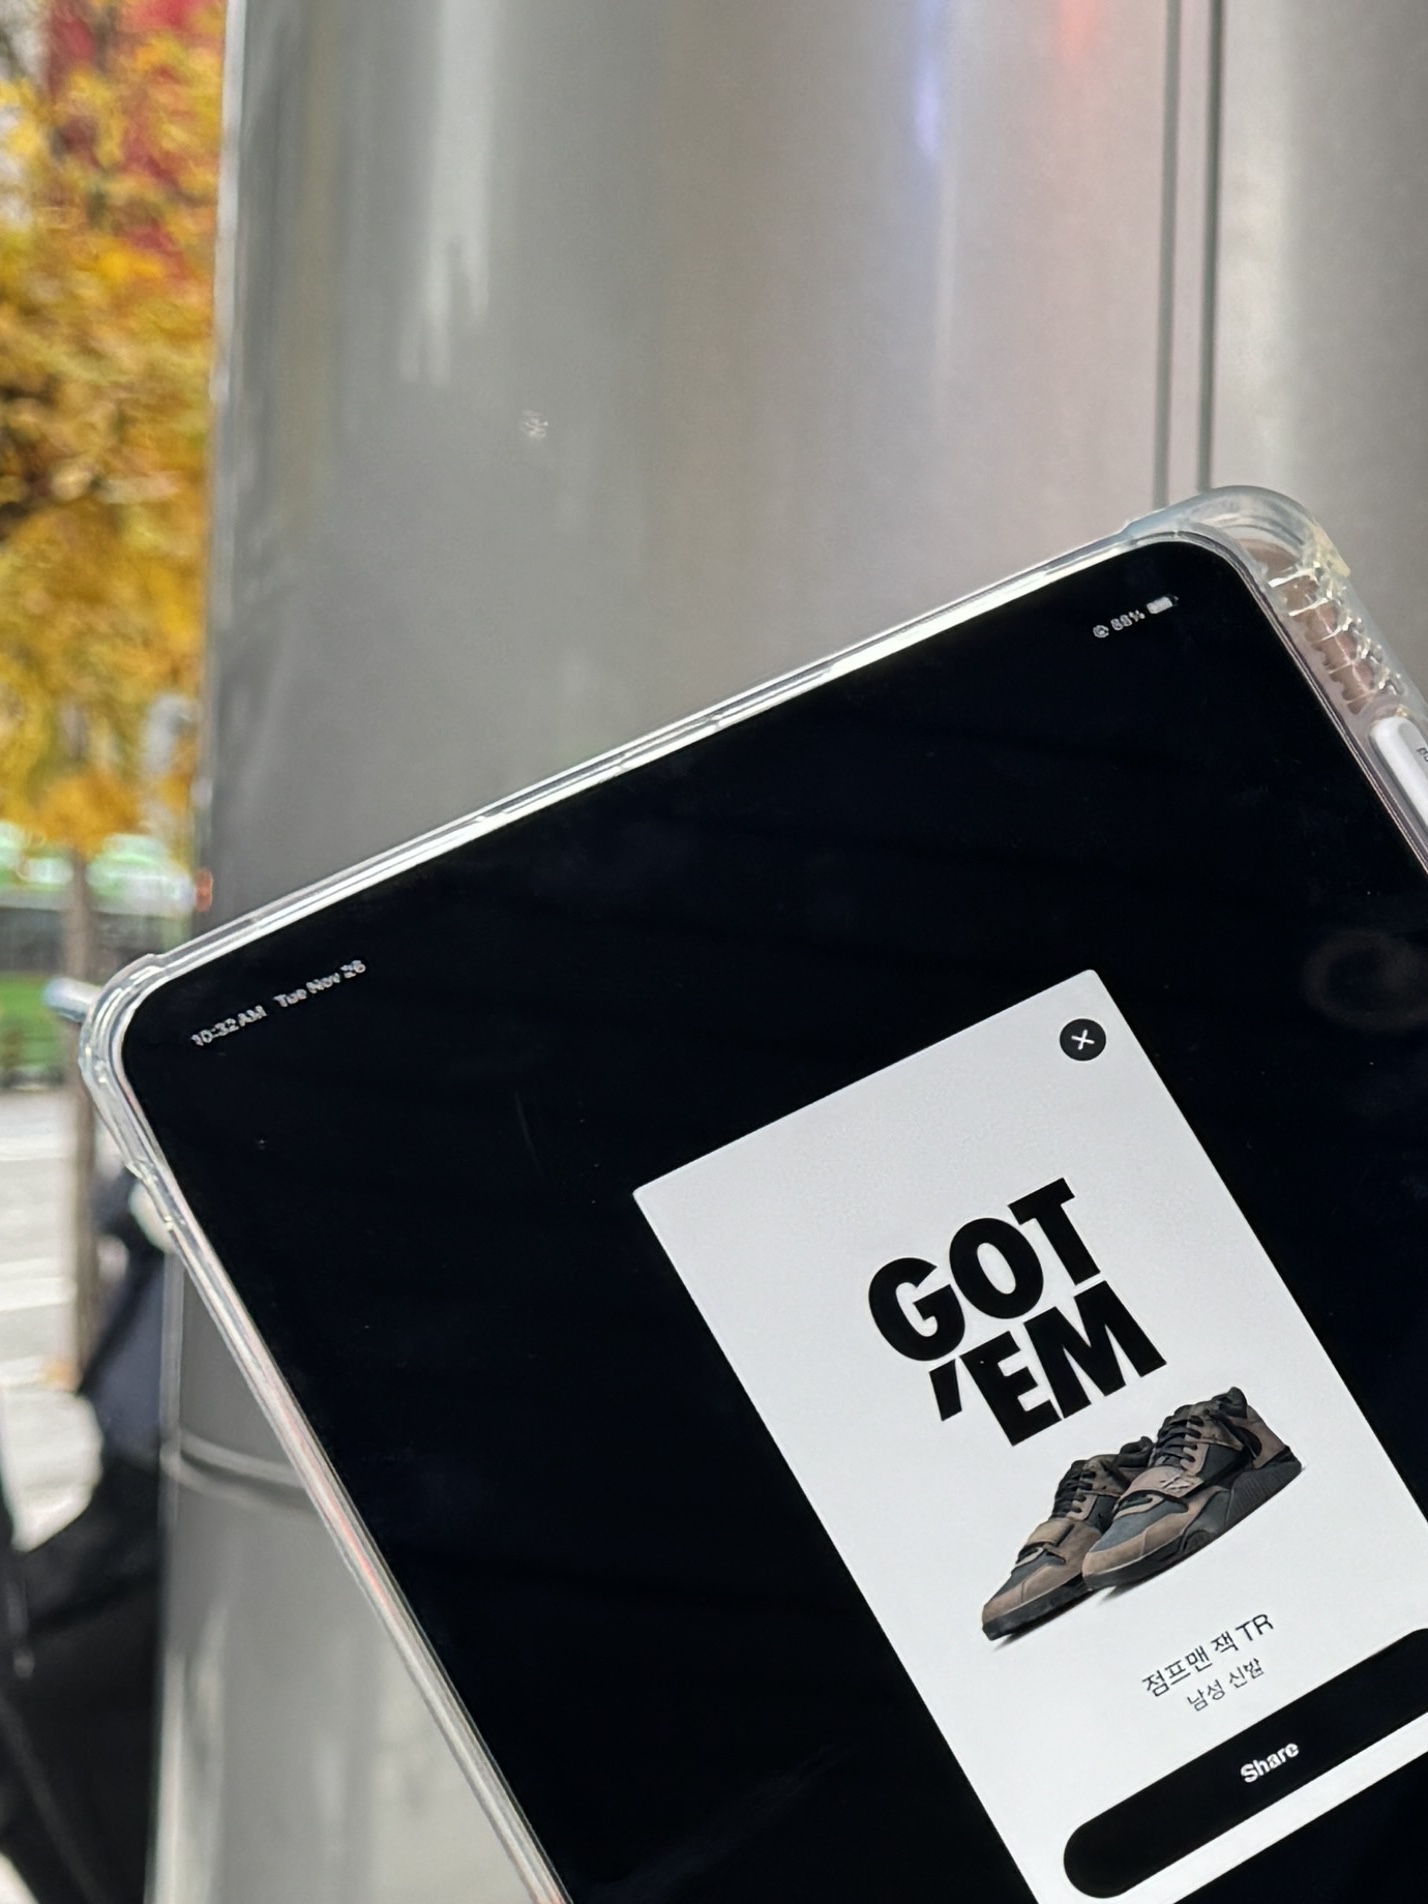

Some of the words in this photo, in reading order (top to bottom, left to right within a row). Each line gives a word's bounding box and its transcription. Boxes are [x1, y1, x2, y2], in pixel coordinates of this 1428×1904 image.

[238, 1004, 268, 1027] AM
[306, 972, 341, 994] Nov
[868, 1176, 1101, 1362] GOT
[1141, 1645, 1213, 1698] 점프맨
[1210, 1630, 1240, 1654] 잭
[1235, 1613, 1275, 1642] TR
[1186, 1679, 1226, 1712] 남성
[1228, 1657, 1265, 1690] 신발
[1240, 1742, 1300, 1784] Share
